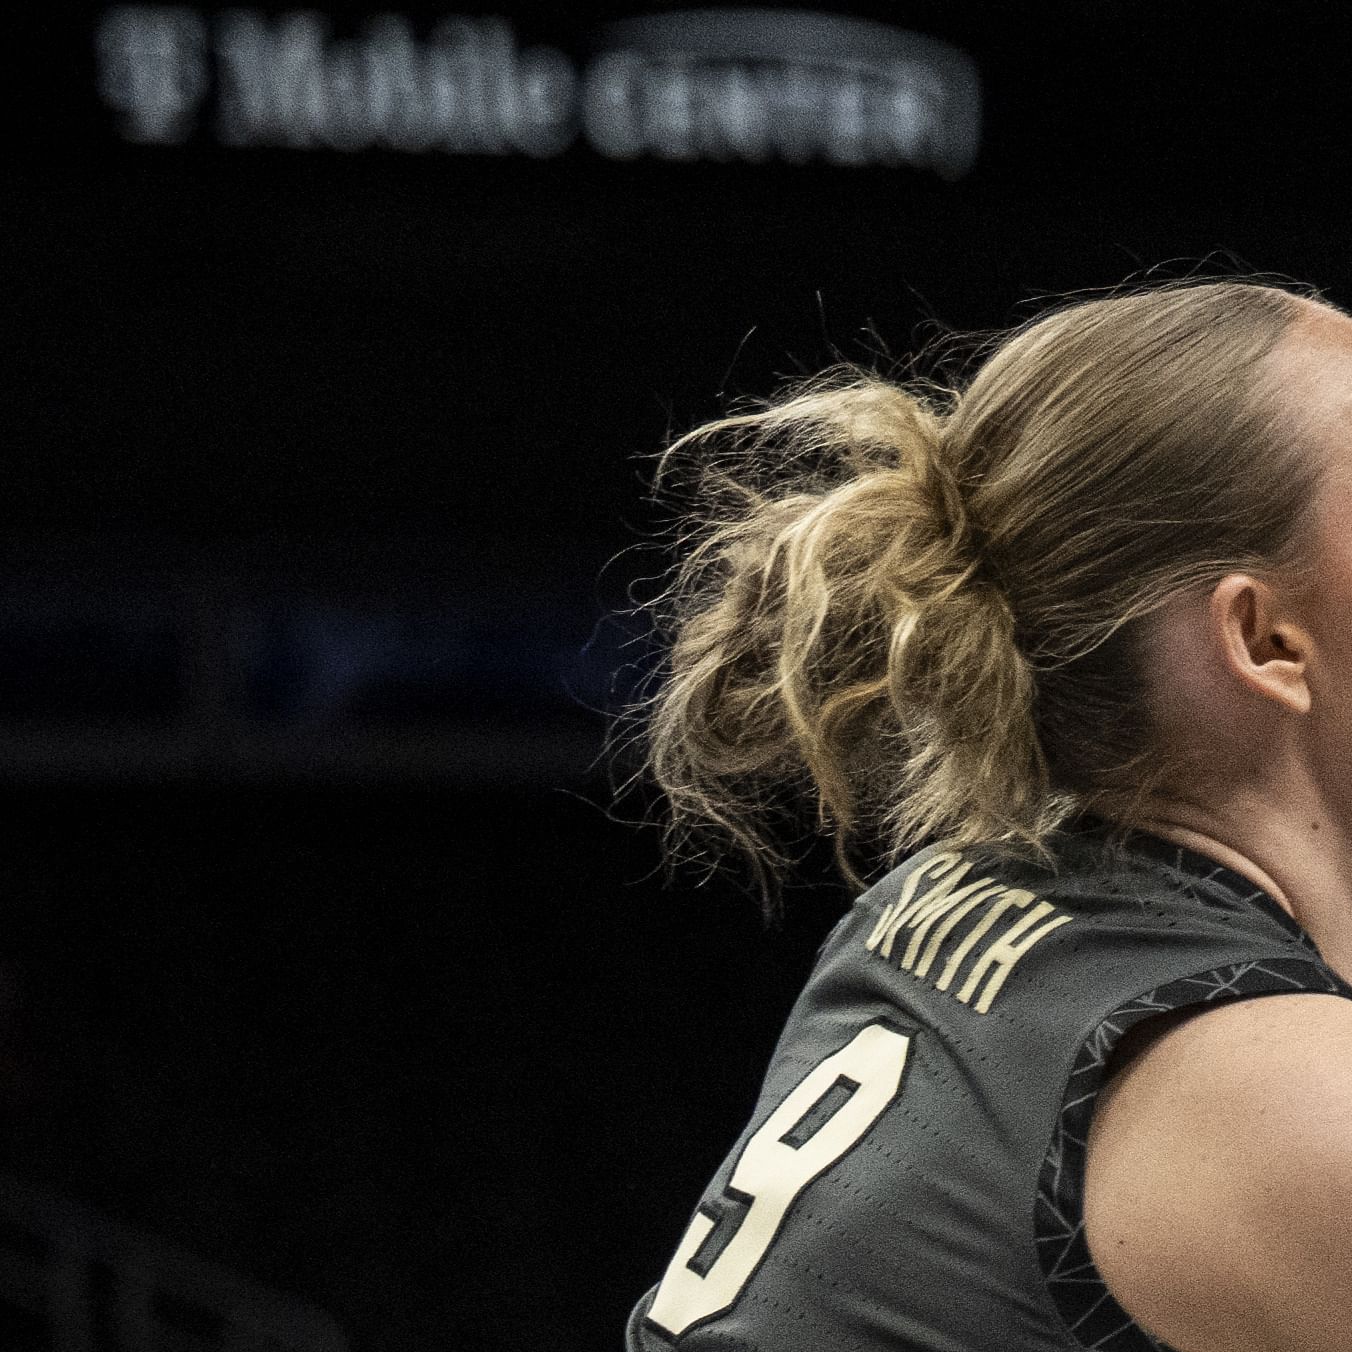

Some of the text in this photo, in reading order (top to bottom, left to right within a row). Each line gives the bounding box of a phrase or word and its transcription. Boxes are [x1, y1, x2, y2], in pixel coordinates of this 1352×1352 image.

[216, 10, 576, 157] Mobile
[584, 49, 962, 162] CENTER
[866, 852, 1074, 1015] SMITH
[646, 1022, 911, 1336] 9
